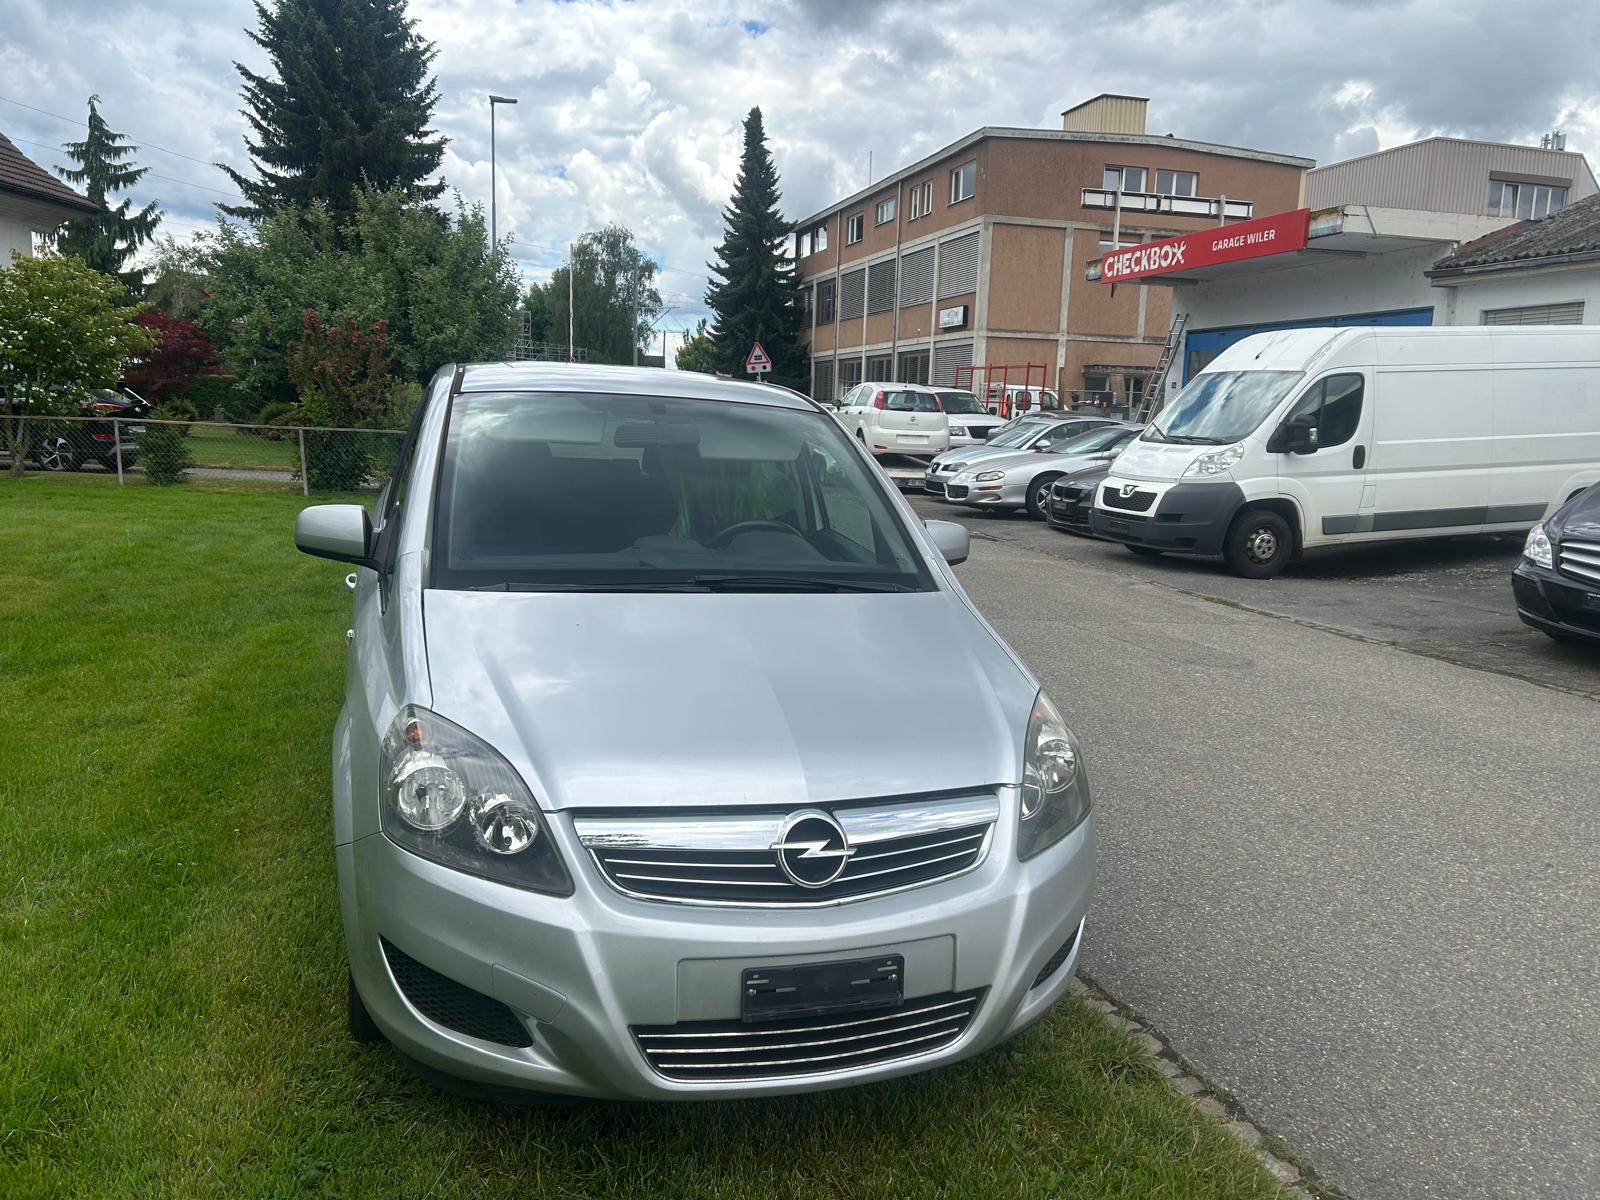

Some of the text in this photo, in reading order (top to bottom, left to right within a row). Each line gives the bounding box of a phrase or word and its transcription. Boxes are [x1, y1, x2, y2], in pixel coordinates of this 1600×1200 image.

[1212, 229, 1276, 252] GARAGE WILER
[1104, 240, 1187, 277] CHECKBOX
